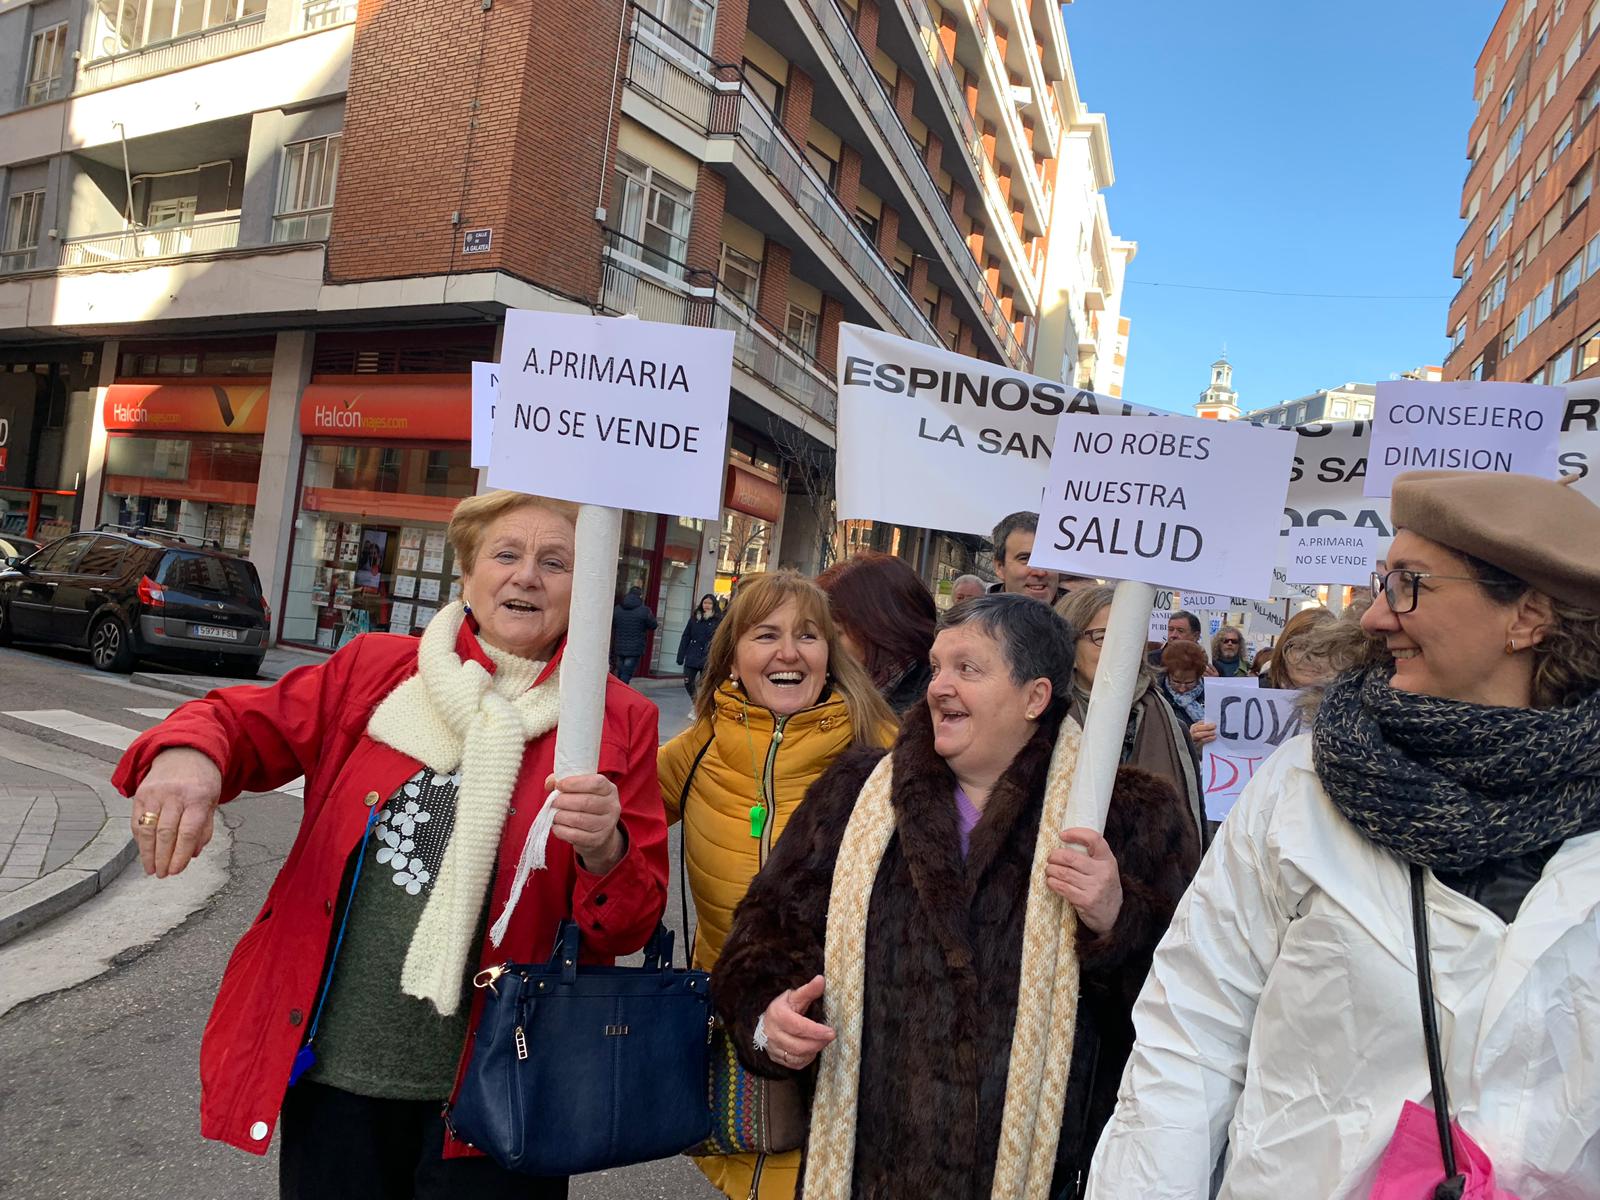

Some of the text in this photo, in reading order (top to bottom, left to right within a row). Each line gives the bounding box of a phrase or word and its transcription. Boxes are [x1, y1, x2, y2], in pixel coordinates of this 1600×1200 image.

[522, 347, 690, 393] A.PRIMARIA
[843, 356, 1100, 415] ESPINOSA
[514, 402, 551, 433] NO
[557, 409, 587, 438] SE
[595, 414, 701, 453] VENDE
[1388, 403, 1544, 431] CONSEJERO
[918, 417, 965, 448] LA
[1073, 431, 1211, 461] NO ROBES
[1383, 446, 1513, 473] DIMISION
[1063, 480, 1187, 510] NUESTRA
[1053, 515, 1204, 563] SALUD
[1298, 536, 1364, 548] A.PRIMARIA
[1295, 555, 1368, 567] NO SE VENDE
[1183, 595, 1216, 606] SALUD
